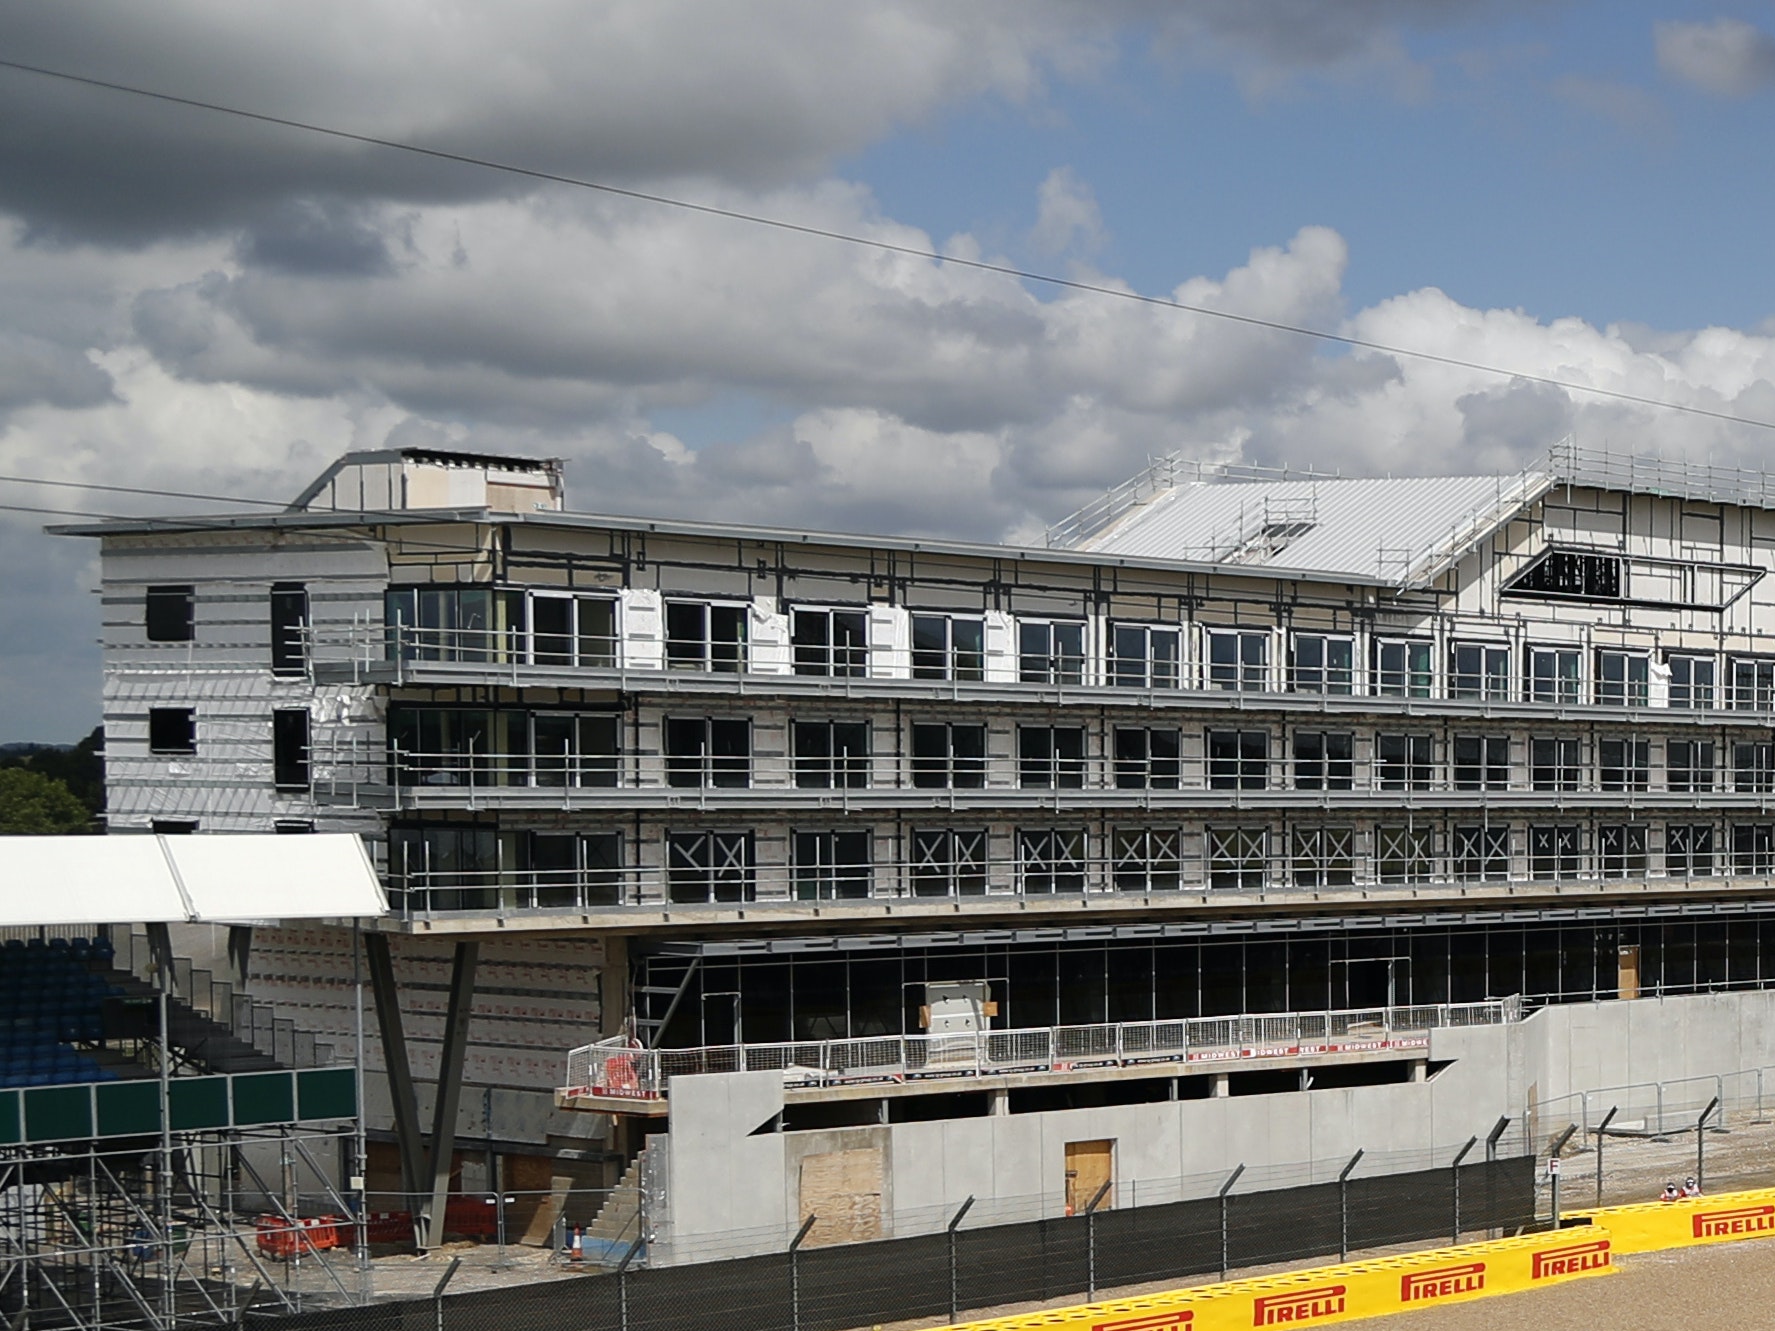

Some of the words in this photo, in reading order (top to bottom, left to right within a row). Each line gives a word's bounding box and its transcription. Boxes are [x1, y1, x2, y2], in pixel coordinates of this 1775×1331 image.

[1550, 1159, 1559, 1173] F
[1692, 1205, 1775, 1238] PIRELLI
[1533, 1240, 1610, 1279] PIRELLI
[1401, 1262, 1486, 1302] PIRELLI
[1253, 1285, 1346, 1327] PIRELLI
